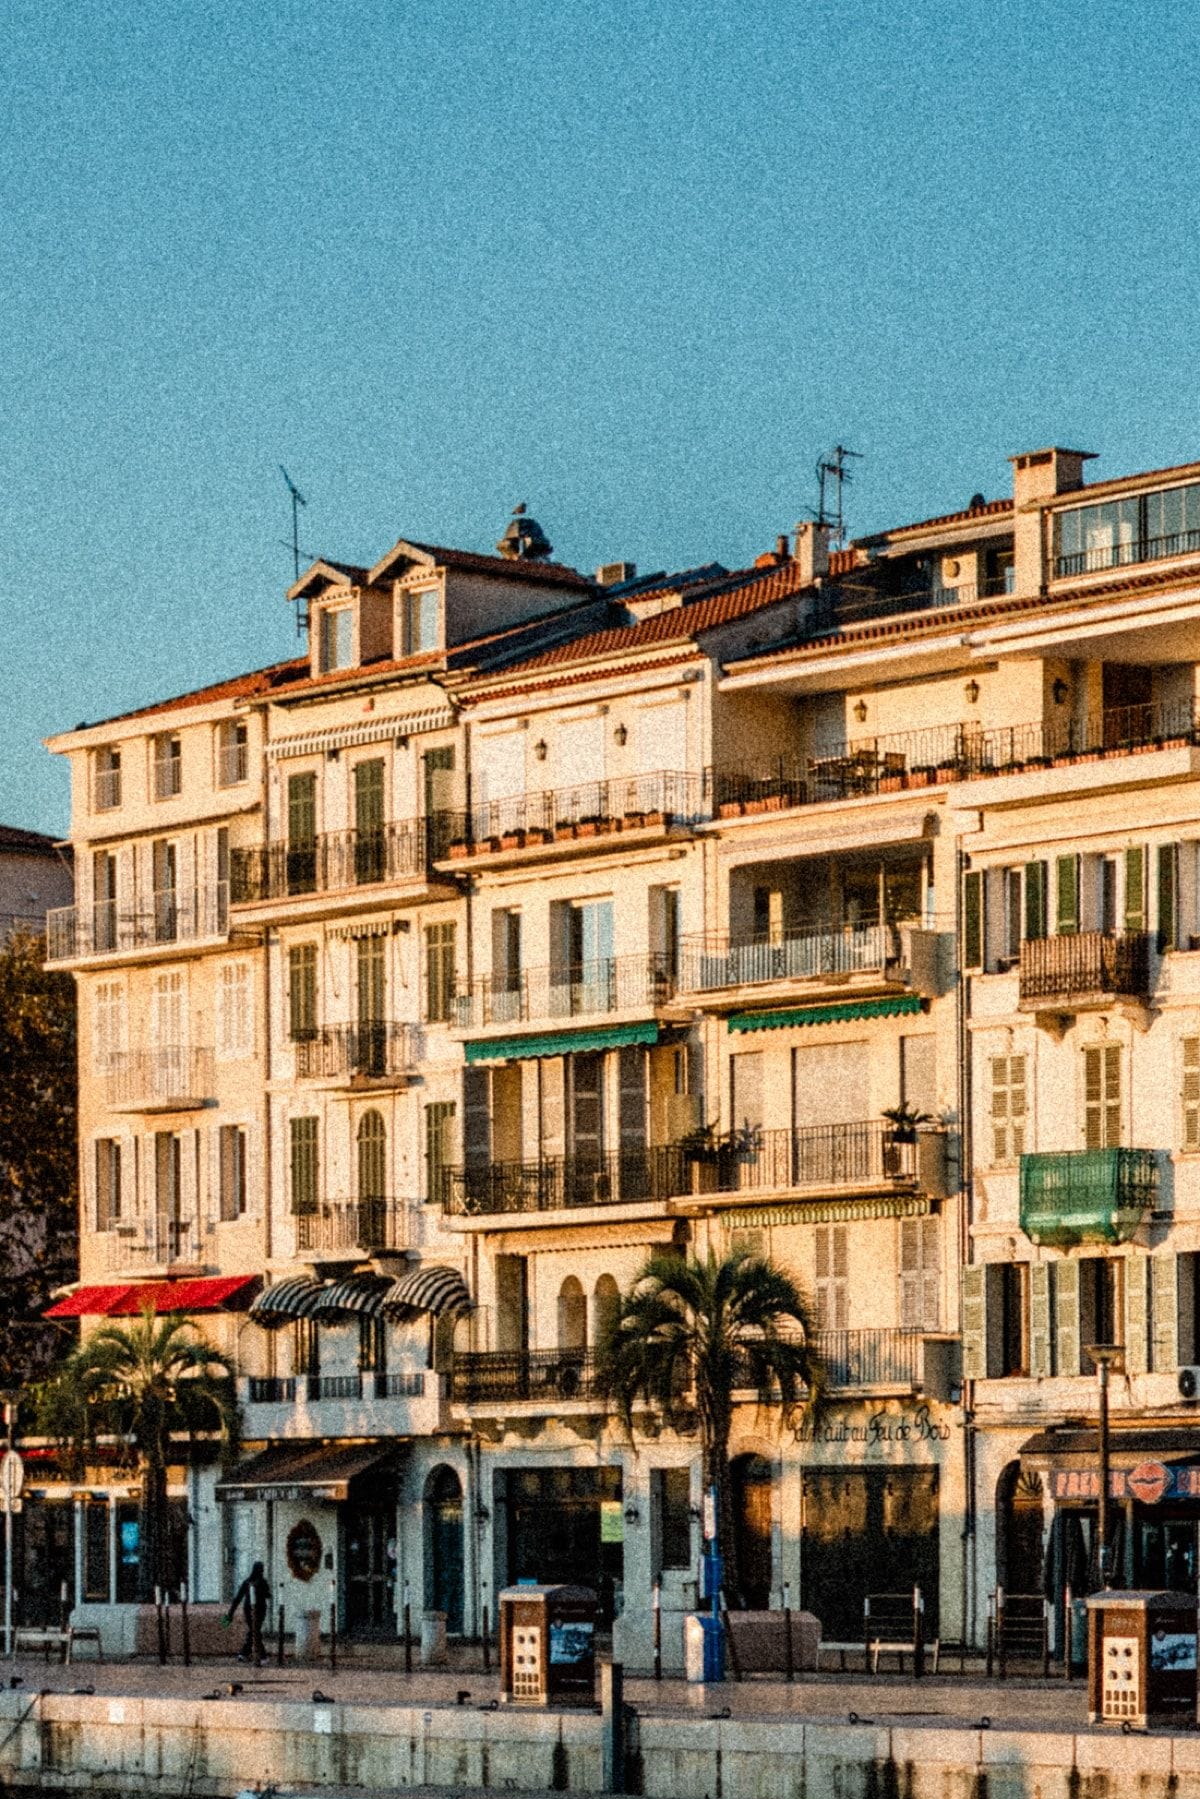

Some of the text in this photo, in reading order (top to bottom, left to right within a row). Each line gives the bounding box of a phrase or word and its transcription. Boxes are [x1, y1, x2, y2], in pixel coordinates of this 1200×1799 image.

[851, 1425, 868, 1442] au
[867, 1410, 893, 1446] Feu
[895, 1418, 912, 1442] de
[913, 1404, 952, 1443] Bois
[1056, 1471, 1127, 1497] FRENH
